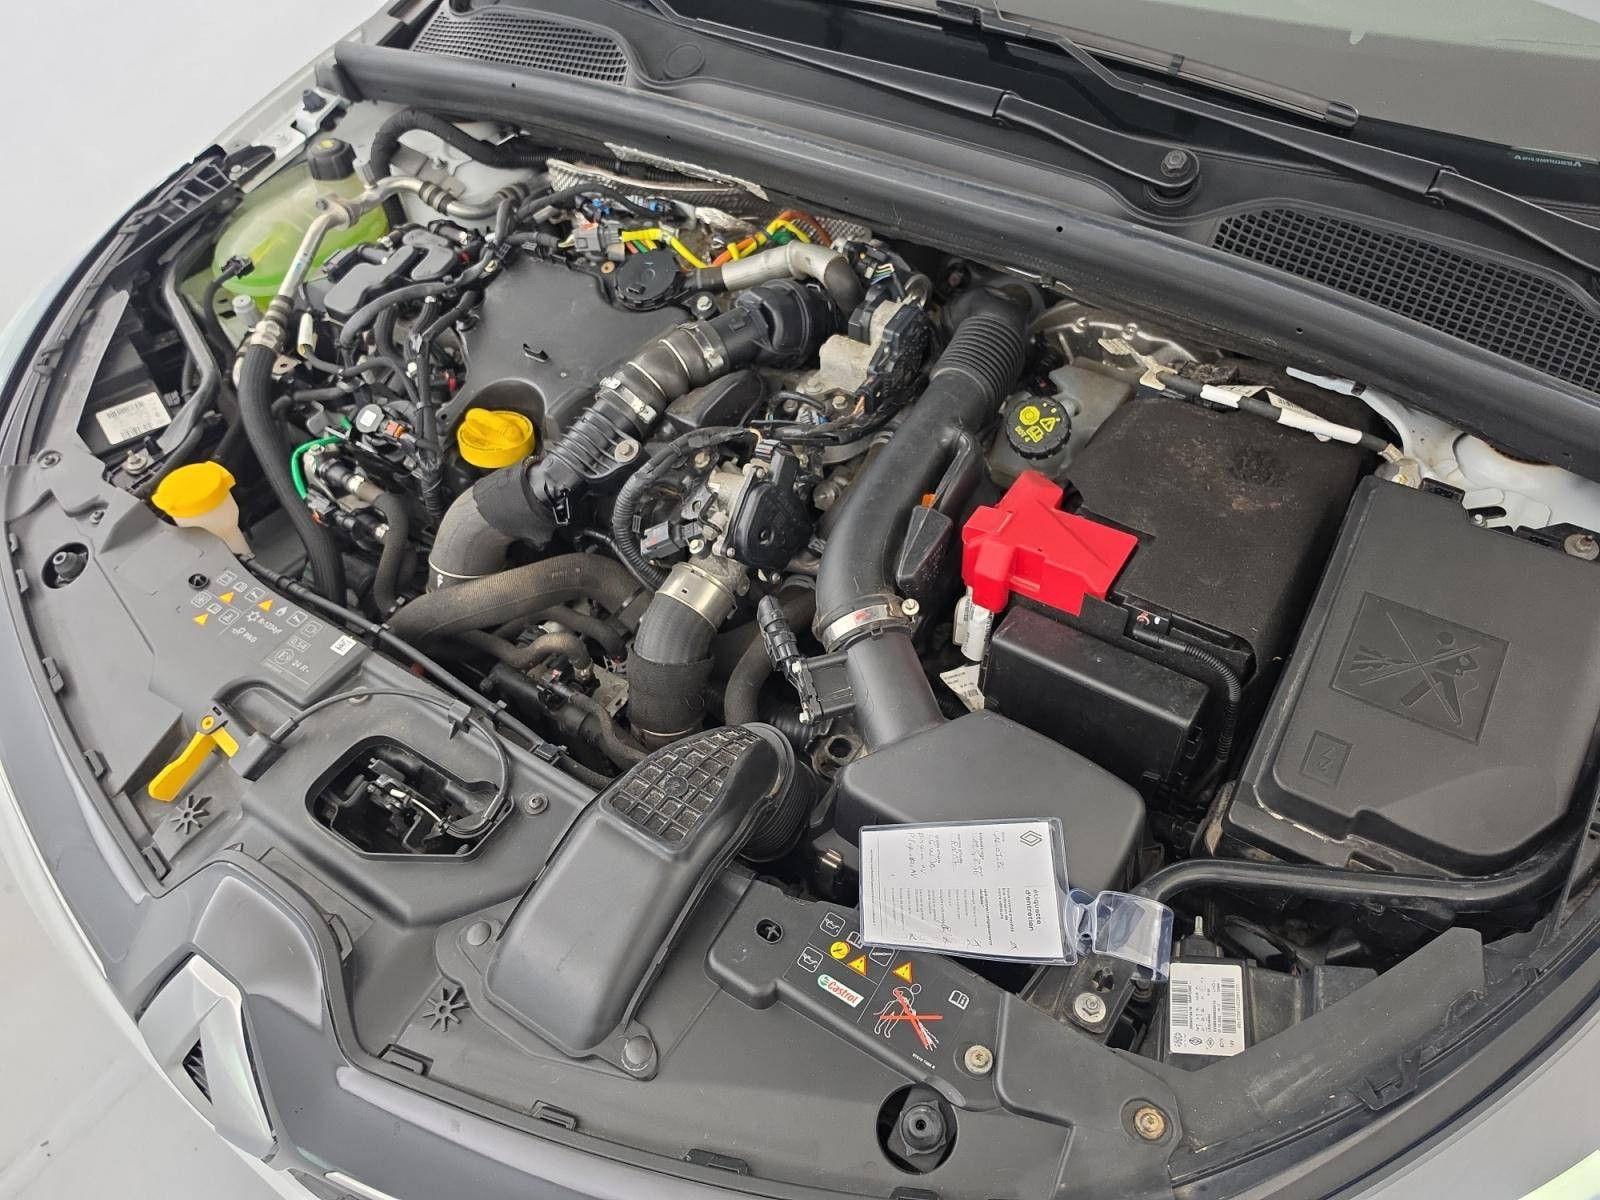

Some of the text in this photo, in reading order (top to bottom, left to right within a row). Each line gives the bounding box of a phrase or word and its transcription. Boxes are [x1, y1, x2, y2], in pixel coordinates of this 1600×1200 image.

[243, 631, 258, 643] PAG
[1025, 889, 1034, 932] d'entretien
[1033, 889, 1042, 924] étiquette
[828, 981, 859, 1004] Castrol
